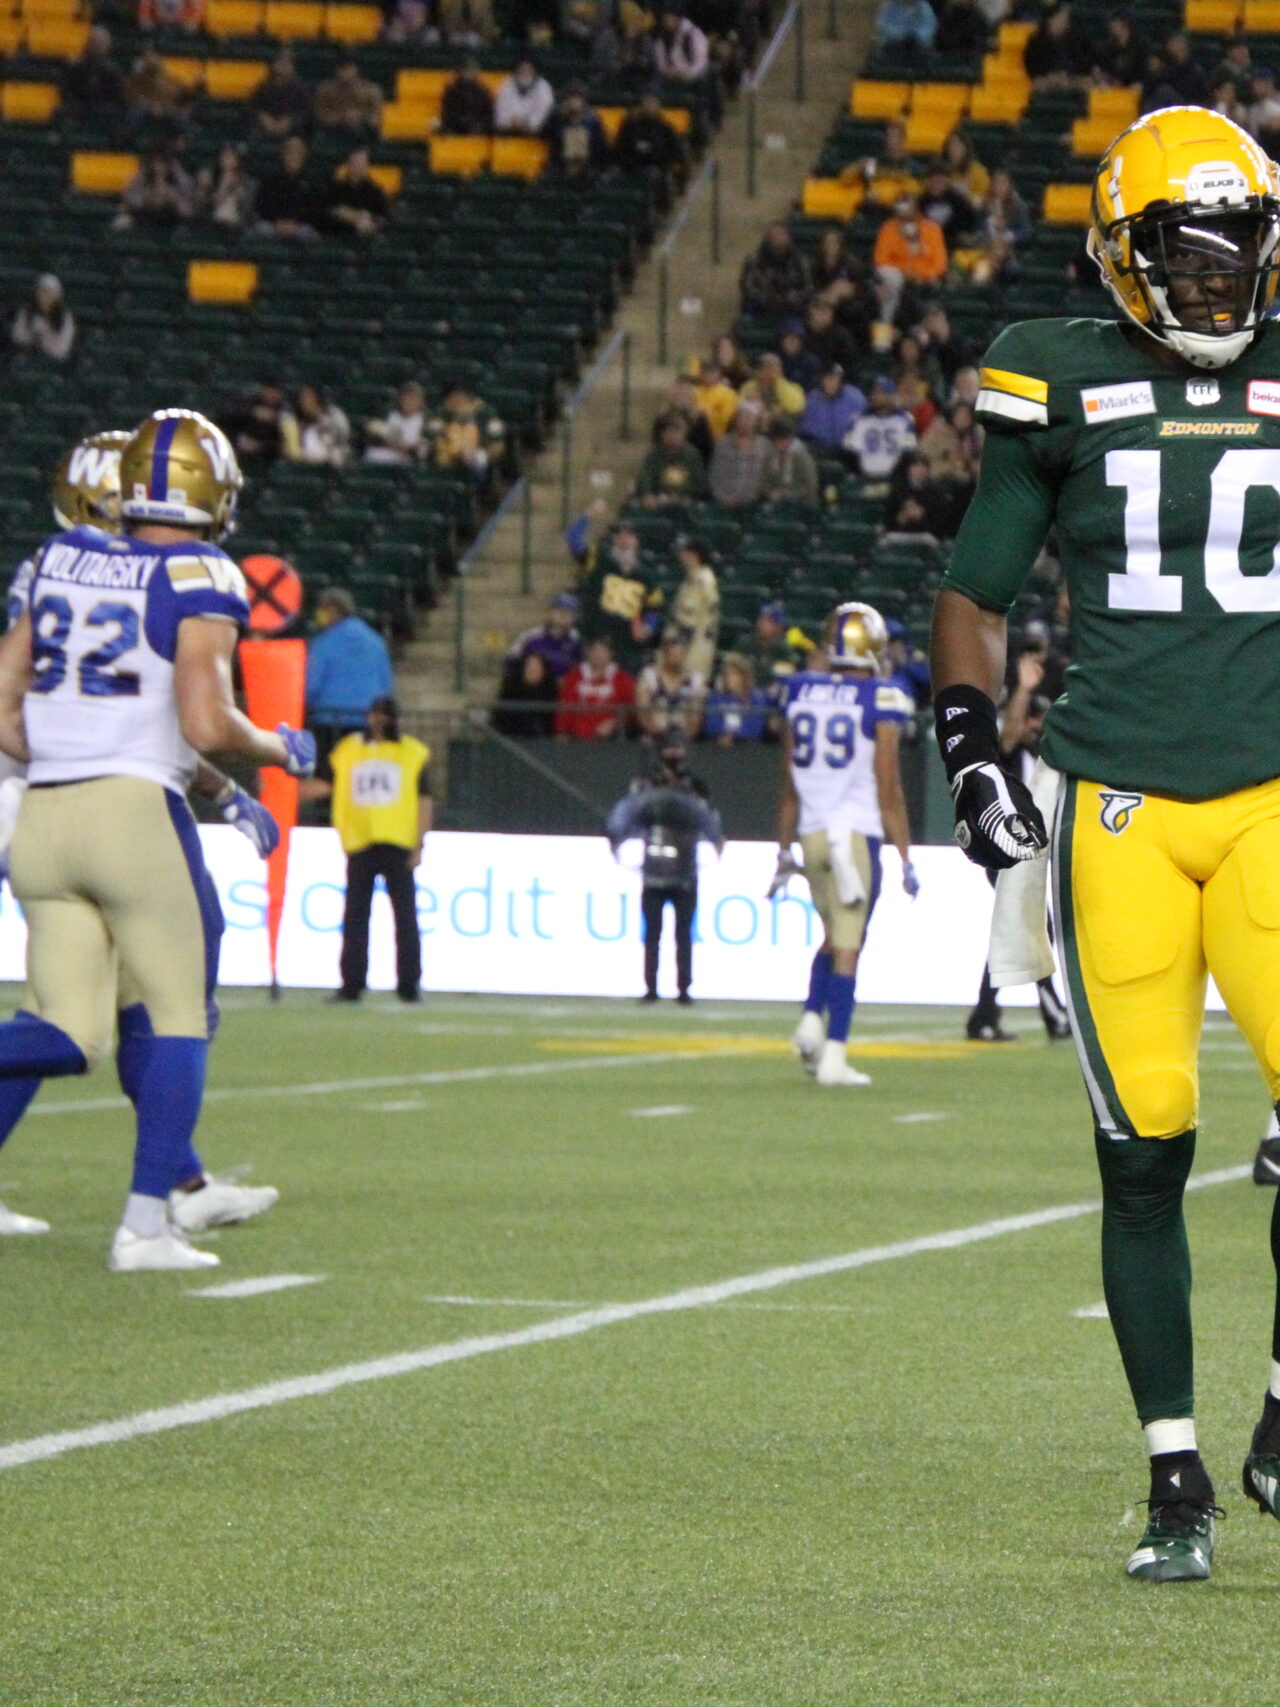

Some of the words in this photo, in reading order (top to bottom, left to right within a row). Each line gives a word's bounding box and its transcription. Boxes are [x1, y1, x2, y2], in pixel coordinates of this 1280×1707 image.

[1203, 179, 1235, 188] ELKS
[1099, 391, 1152, 411] Mark's
[1159, 420, 1260, 436] EDMONTON
[40, 542, 161, 589] WOLITARSKY
[300, 866, 556, 940] cedit
[586, 889, 815, 946] uon
